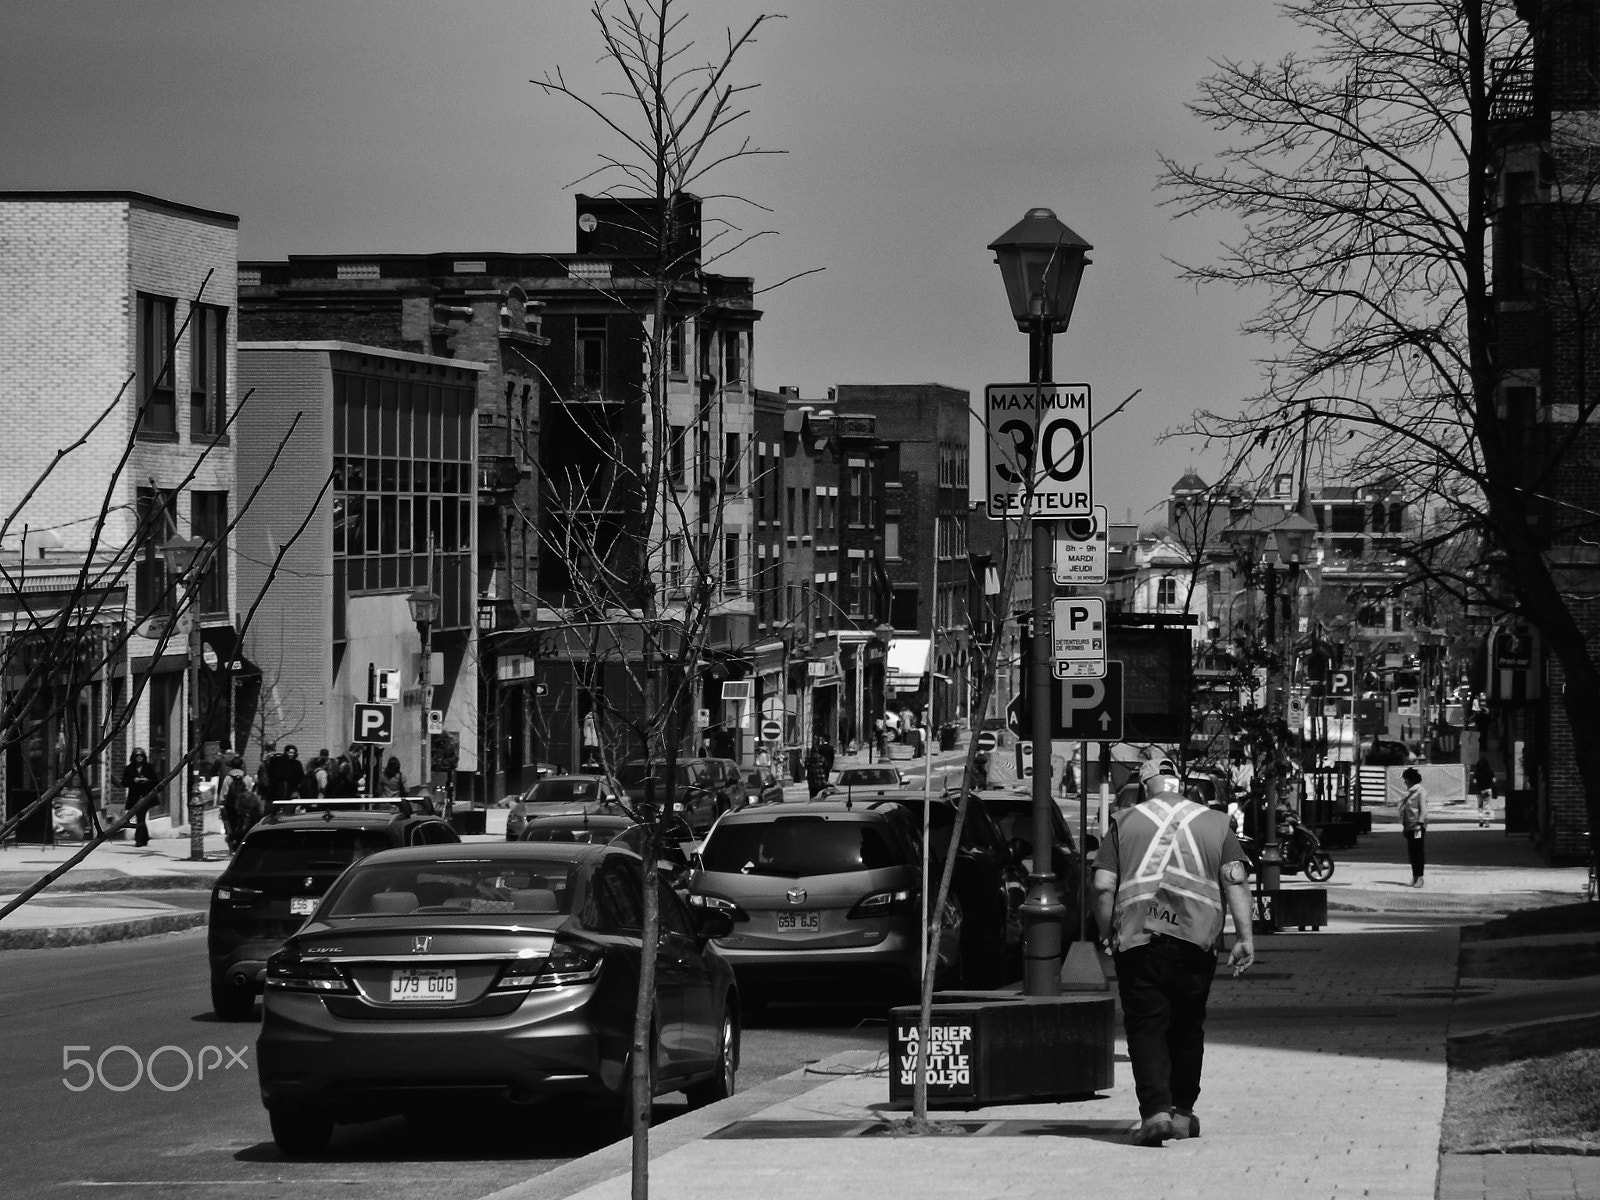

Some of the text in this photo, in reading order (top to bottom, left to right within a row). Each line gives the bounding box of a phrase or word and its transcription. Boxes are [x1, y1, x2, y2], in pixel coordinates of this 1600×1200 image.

[991, 393, 1085, 410] MAXMUM
[995, 418, 1084, 484] 30
[1065, 544, 1076, 552] 8h
[1086, 544, 1097, 552] 9h
[1070, 606, 1089, 631] P
[1058, 661, 1070, 675] P
[1332, 673, 1348, 693] P
[1061, 679, 1106, 728] P
[361, 709, 385, 737] P
[307, 946, 344, 954] CIVIC
[393, 976, 454, 993] J79 GQG
[898, 1026, 972, 1041] LARIER
[948, 1055, 970, 1070] LE
[900, 1069, 970, 1091] DÉTOR
